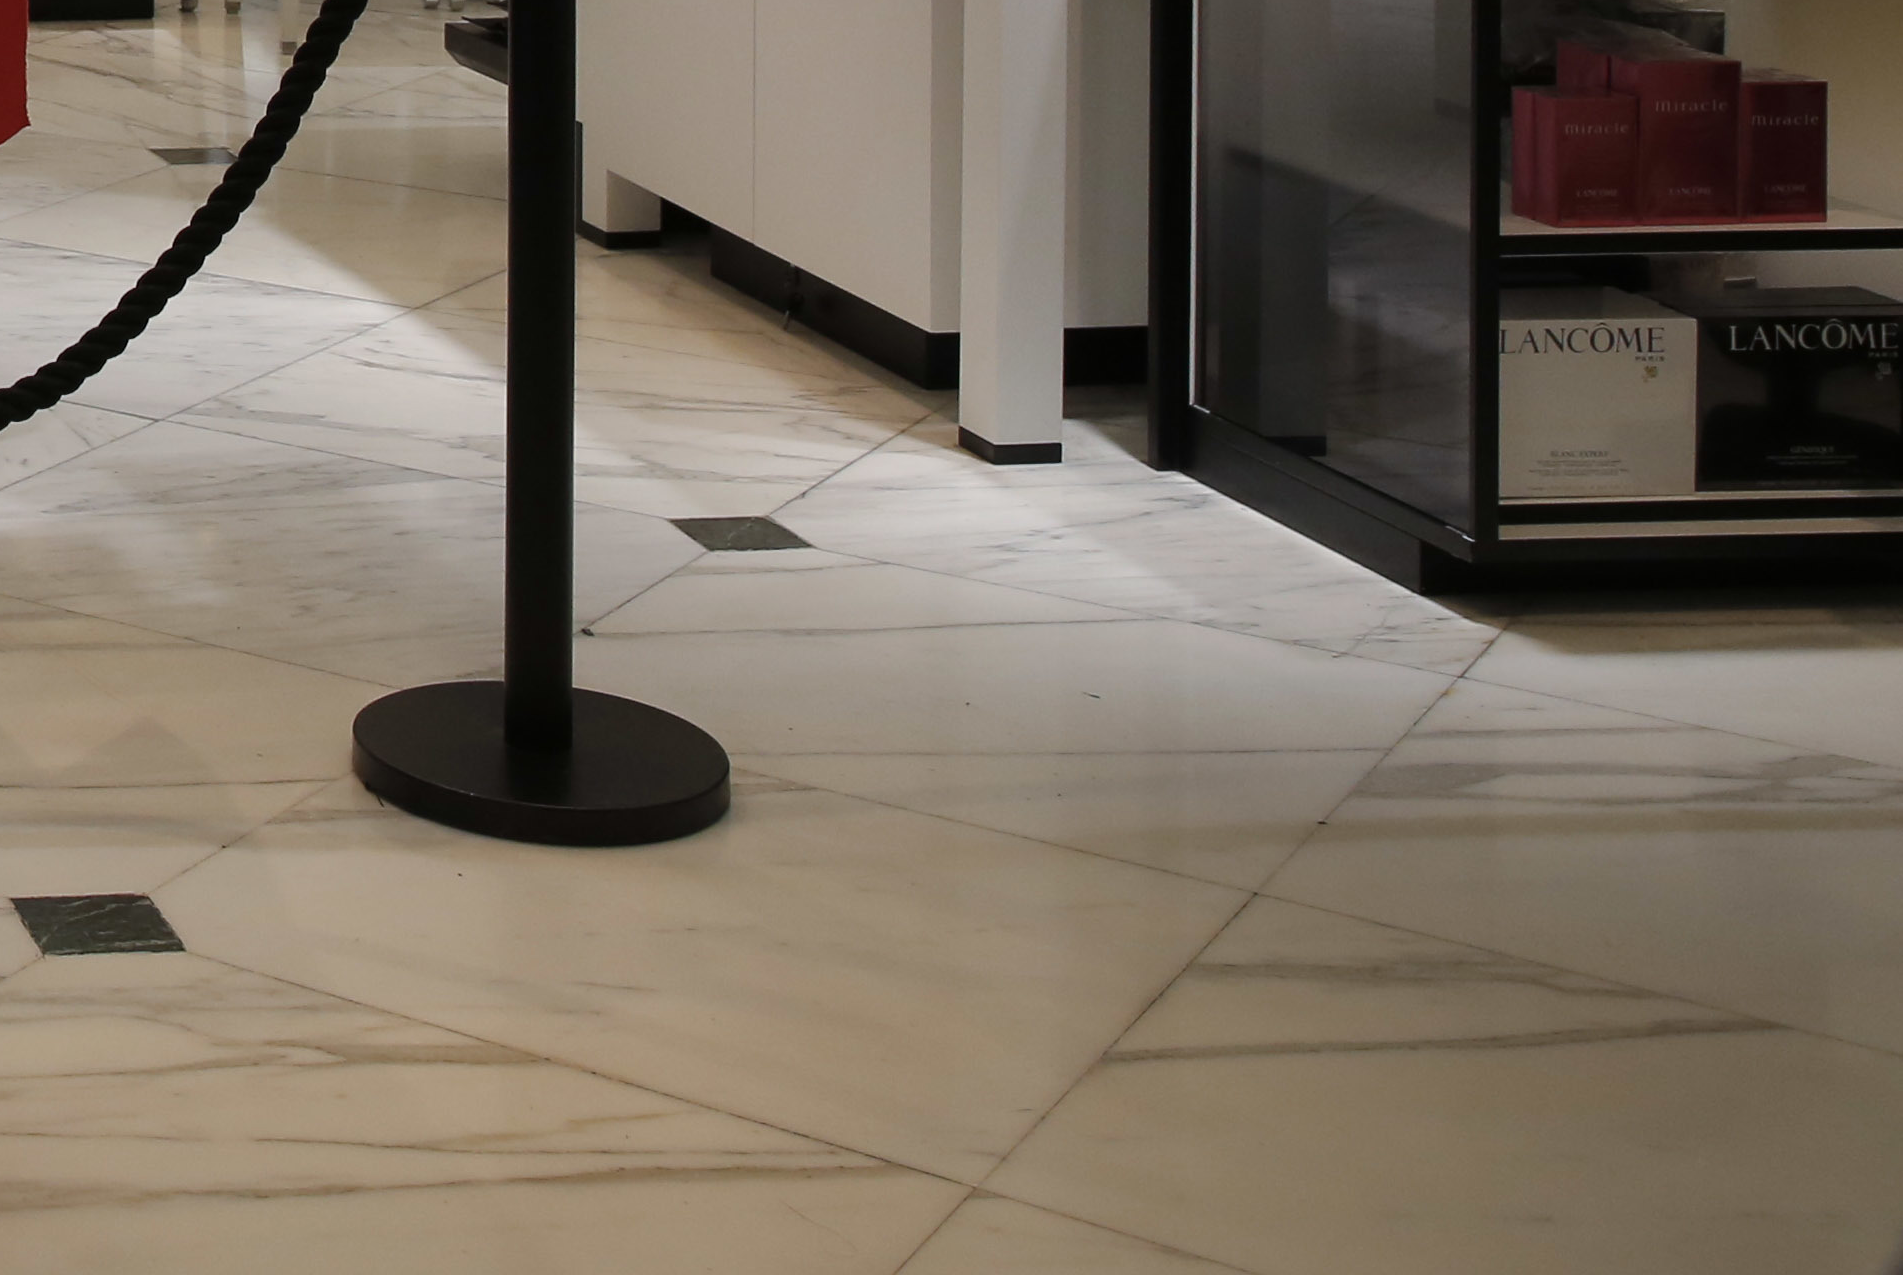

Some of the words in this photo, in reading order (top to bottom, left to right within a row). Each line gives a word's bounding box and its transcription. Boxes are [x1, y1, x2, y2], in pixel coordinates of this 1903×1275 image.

[1655, 99, 1729, 113] miracle
[1751, 113, 1820, 127] miracle
[1564, 122, 1630, 136] miracle
[1499, 322, 1665, 355] LANCÔME
[1729, 317, 1900, 353] LANCÔME
